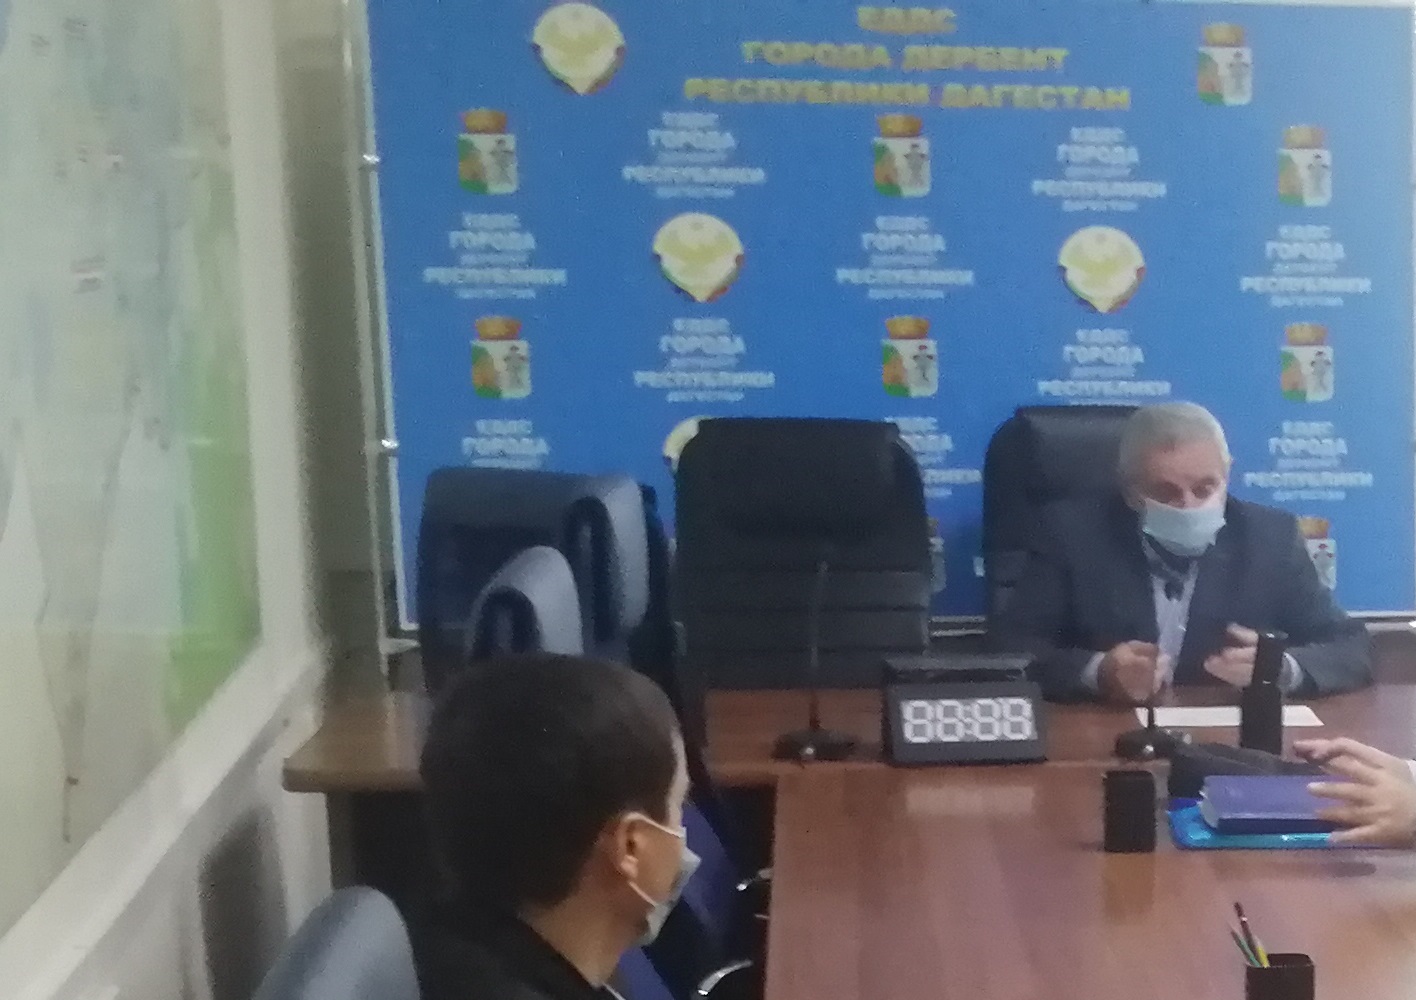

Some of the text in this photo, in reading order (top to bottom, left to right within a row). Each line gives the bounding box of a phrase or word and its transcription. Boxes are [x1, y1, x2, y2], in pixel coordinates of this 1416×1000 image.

[742, 41, 1069, 72] ГОРОДА ДЕРБЕНТ
[684, 78, 1131, 110] РЕСПУБЛИКИ ДАГЕСТАН
